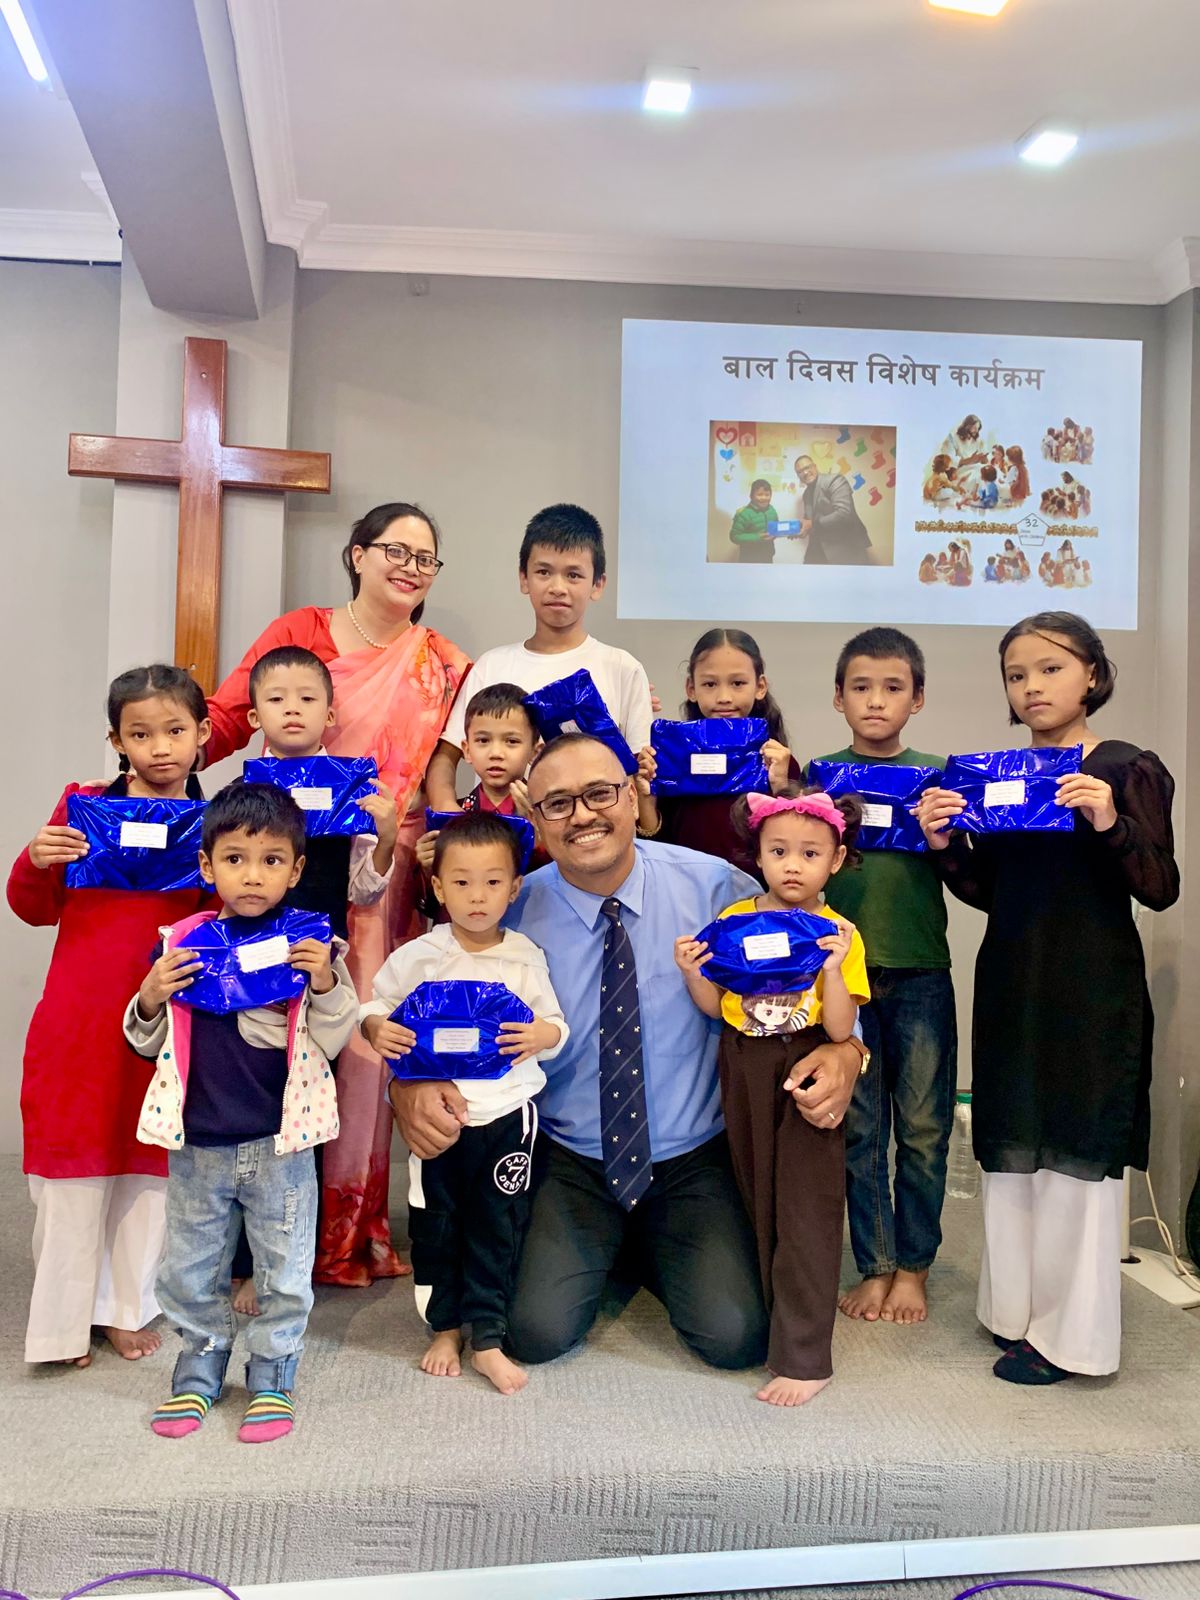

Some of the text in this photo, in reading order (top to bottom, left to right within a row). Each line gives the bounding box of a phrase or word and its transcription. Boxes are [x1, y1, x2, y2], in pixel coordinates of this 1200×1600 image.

[722, 350, 1046, 391] बाल दिवस विशेष कार्यक्रम
[1025, 518, 1039, 528] 32
[507, 1165, 525, 1183] 7
